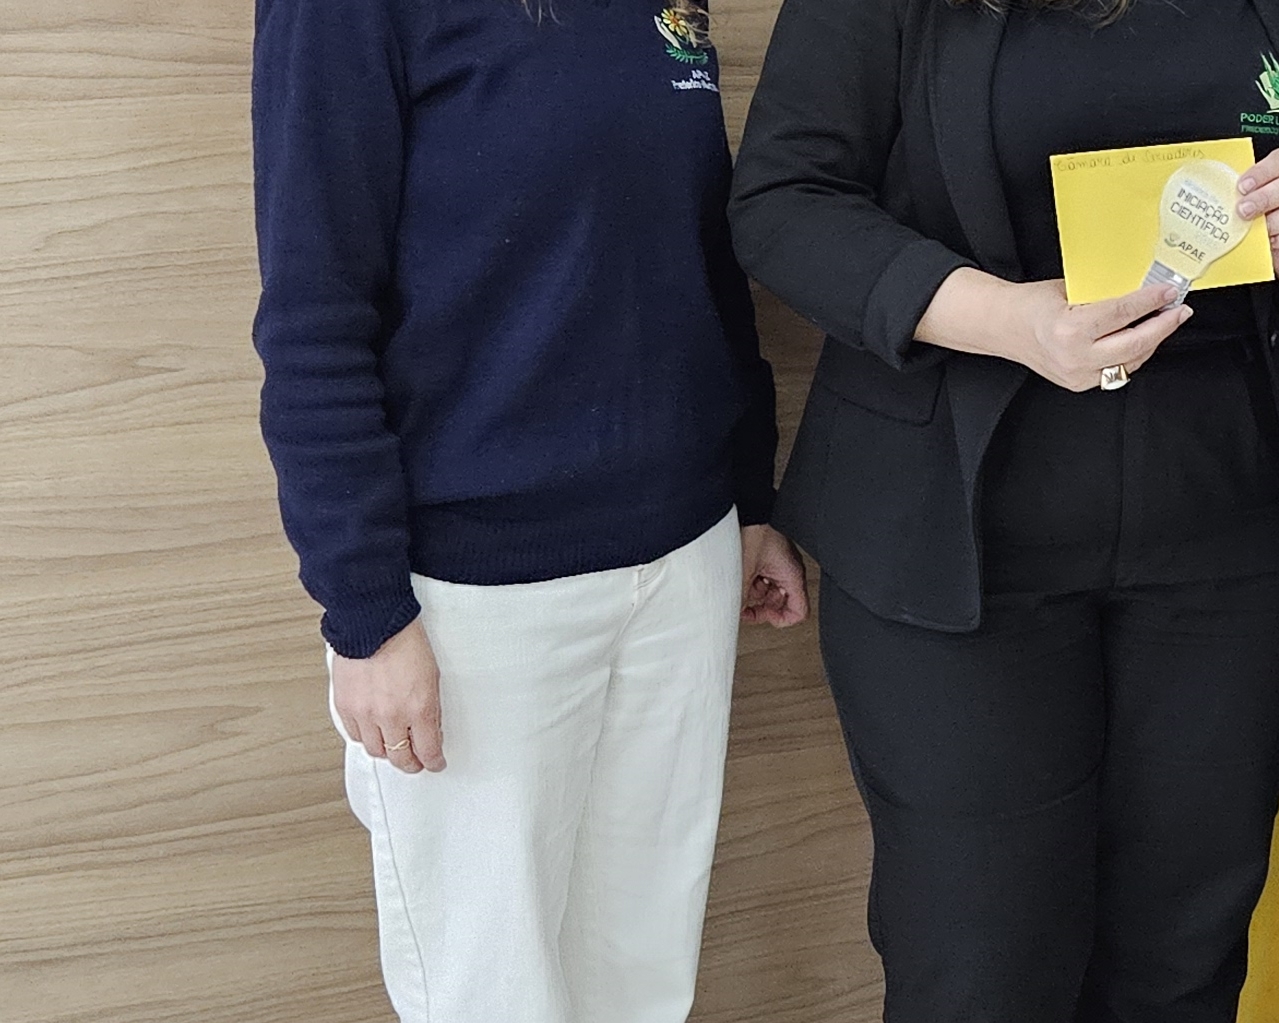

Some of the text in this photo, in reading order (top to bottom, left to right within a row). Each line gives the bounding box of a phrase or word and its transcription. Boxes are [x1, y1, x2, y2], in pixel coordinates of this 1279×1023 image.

[1240, 112, 1274, 125] PODER
[1177, 187, 1229, 225] INICIAÇÃO
[1178, 241, 1206, 261] APAE
